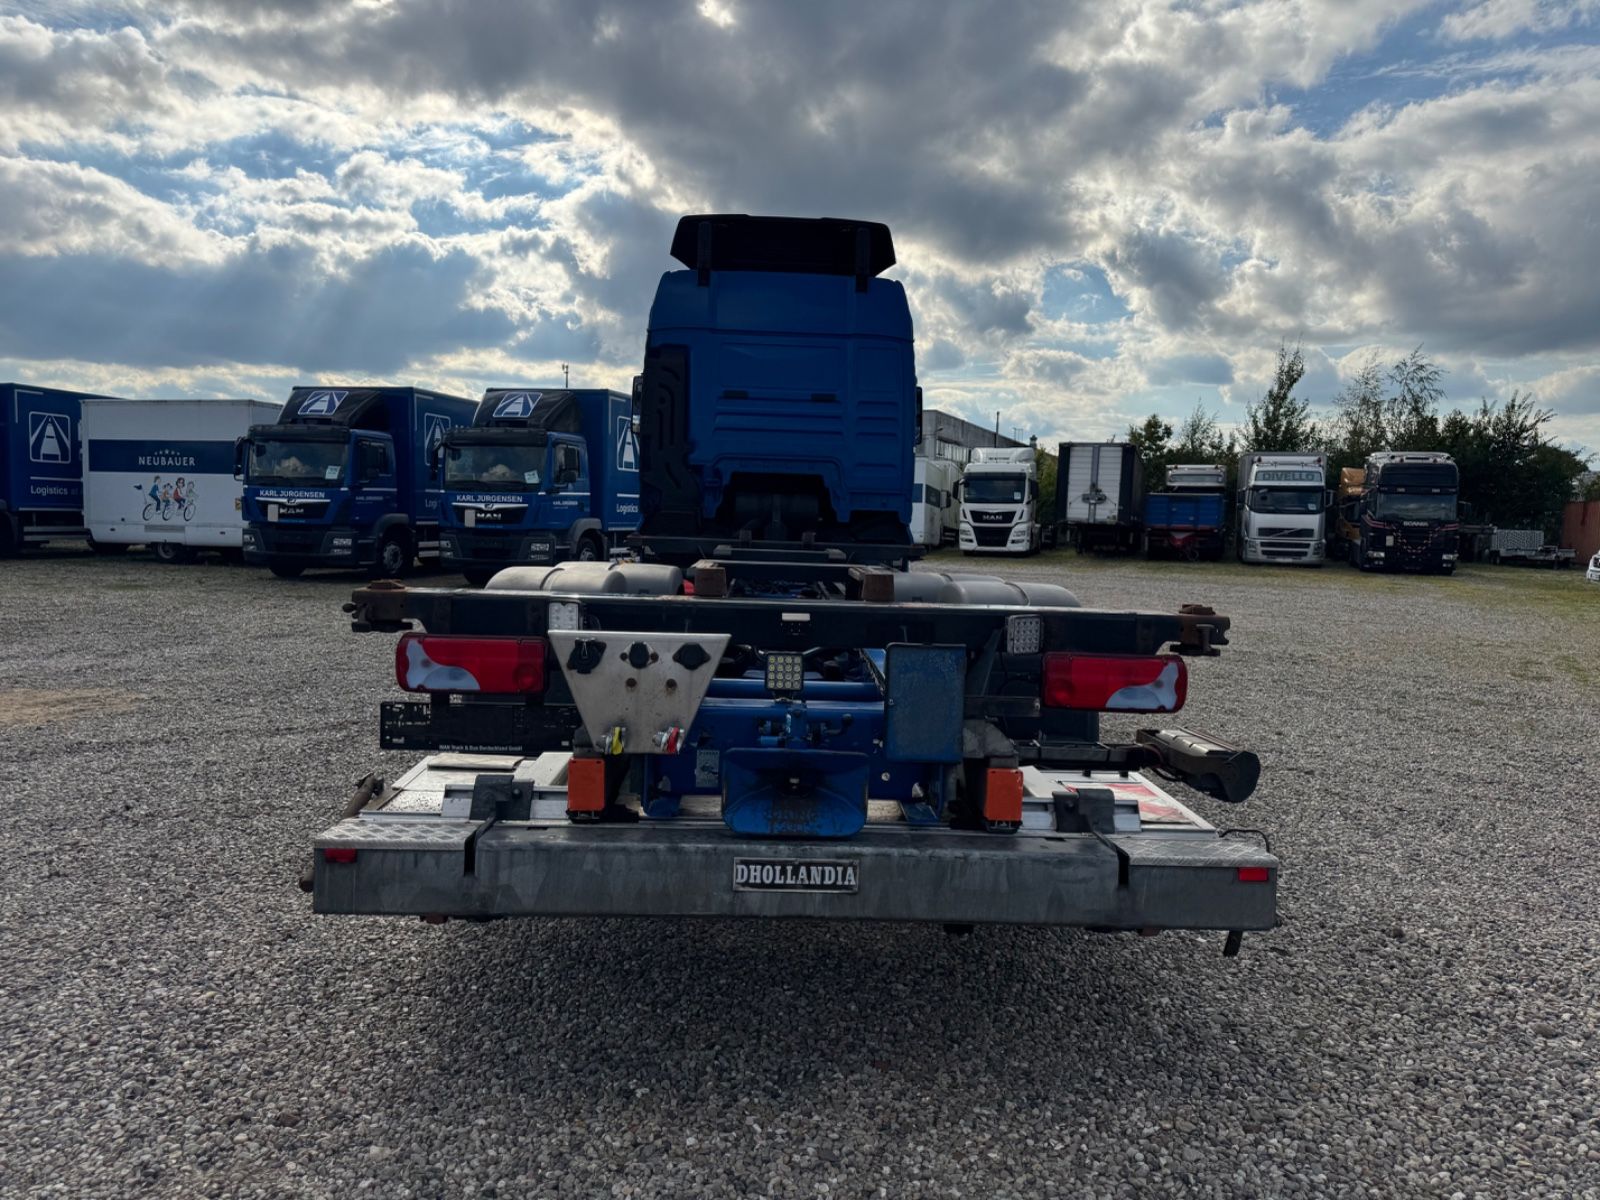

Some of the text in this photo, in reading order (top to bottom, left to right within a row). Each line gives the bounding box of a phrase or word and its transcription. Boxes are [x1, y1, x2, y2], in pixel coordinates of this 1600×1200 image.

[138, 456, 195, 466] NEUBAUER
[30, 485, 68, 497] Logistics
[456, 494, 475, 502] KARL
[616, 503, 639, 515] Logistics
[735, 864, 857, 886] DHOLLANDIA
